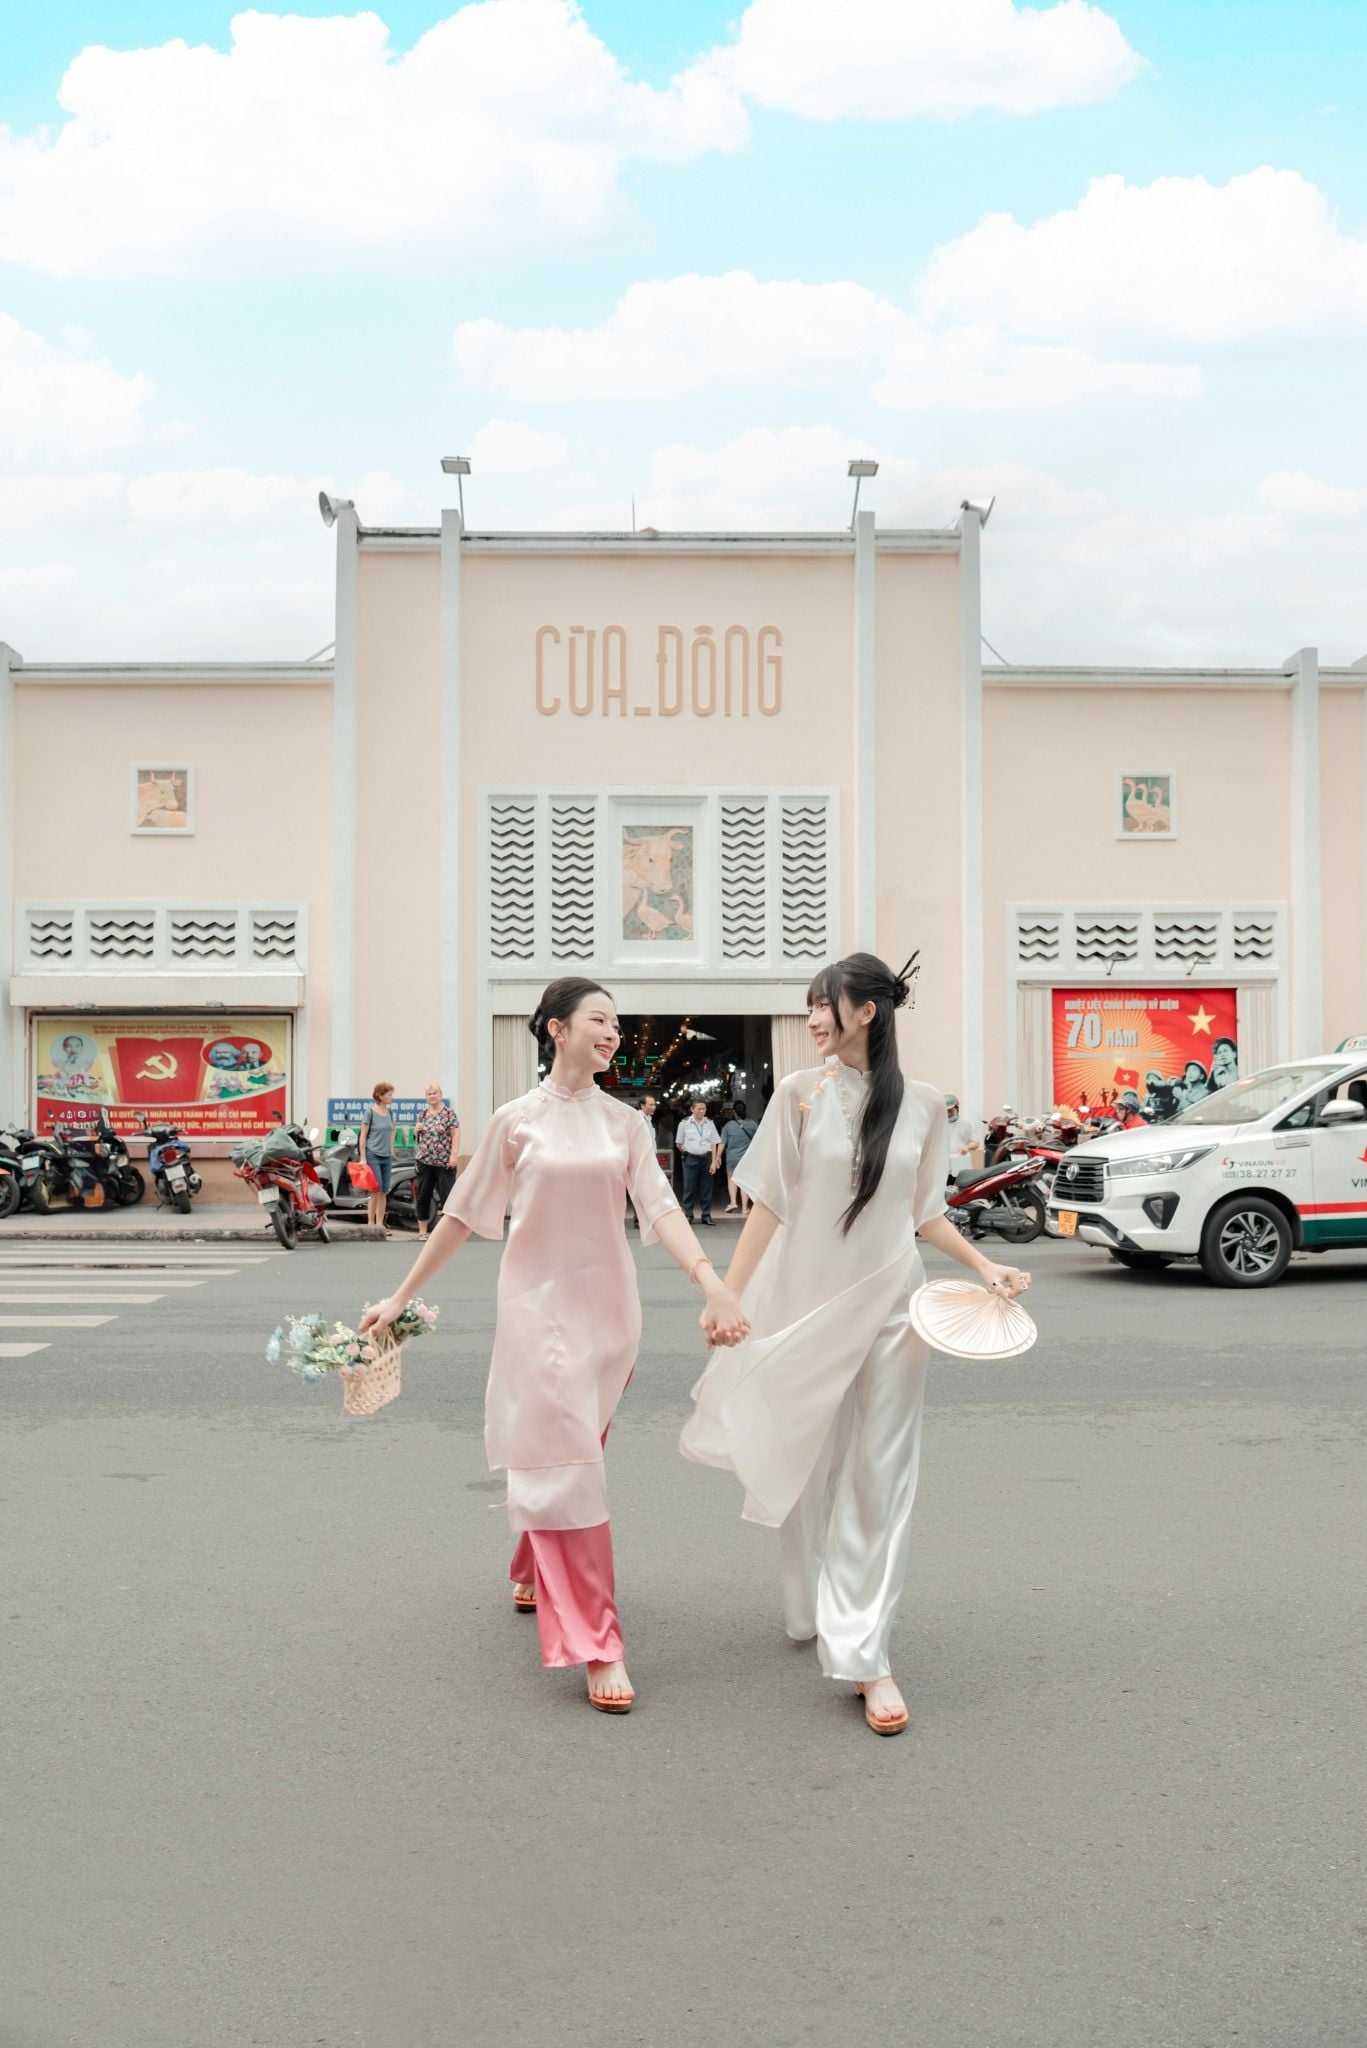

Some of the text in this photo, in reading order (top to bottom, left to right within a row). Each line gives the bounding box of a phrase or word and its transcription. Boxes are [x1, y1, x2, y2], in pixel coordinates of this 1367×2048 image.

[1065, 1013, 1138, 1048] 70 NĂM
[400, 1102, 415, 1110] QUY
[1271, 1168, 1282, 1178] 27
[1286, 1168, 1297, 1178] 27
